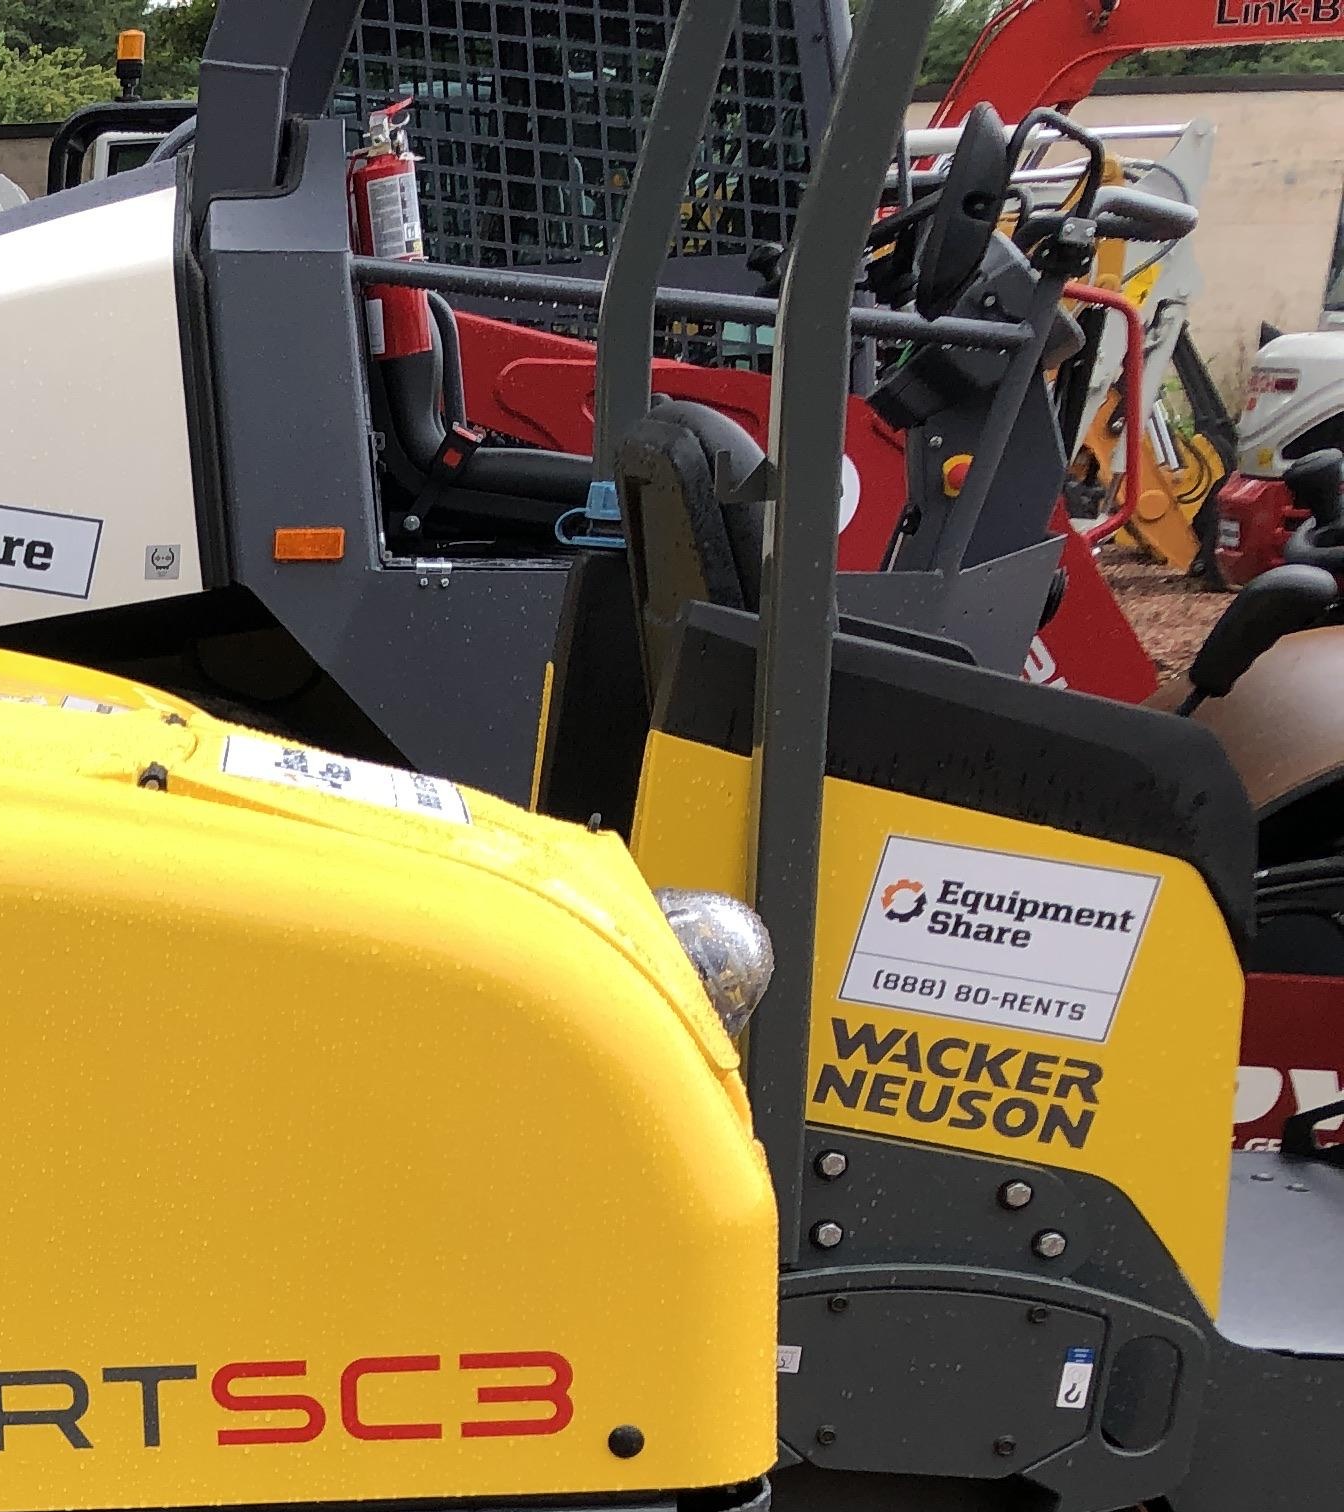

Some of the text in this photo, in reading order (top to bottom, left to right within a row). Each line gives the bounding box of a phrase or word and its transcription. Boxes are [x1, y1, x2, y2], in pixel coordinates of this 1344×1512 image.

[927, 910, 1032, 949] Share
[936, 879, 1136, 933] Equipment
[872, 969, 1087, 1022] (888) 80-RENTS
[831, 1016, 1104, 1105] WACKER
[812, 1063, 1096, 1151] NEUSON
